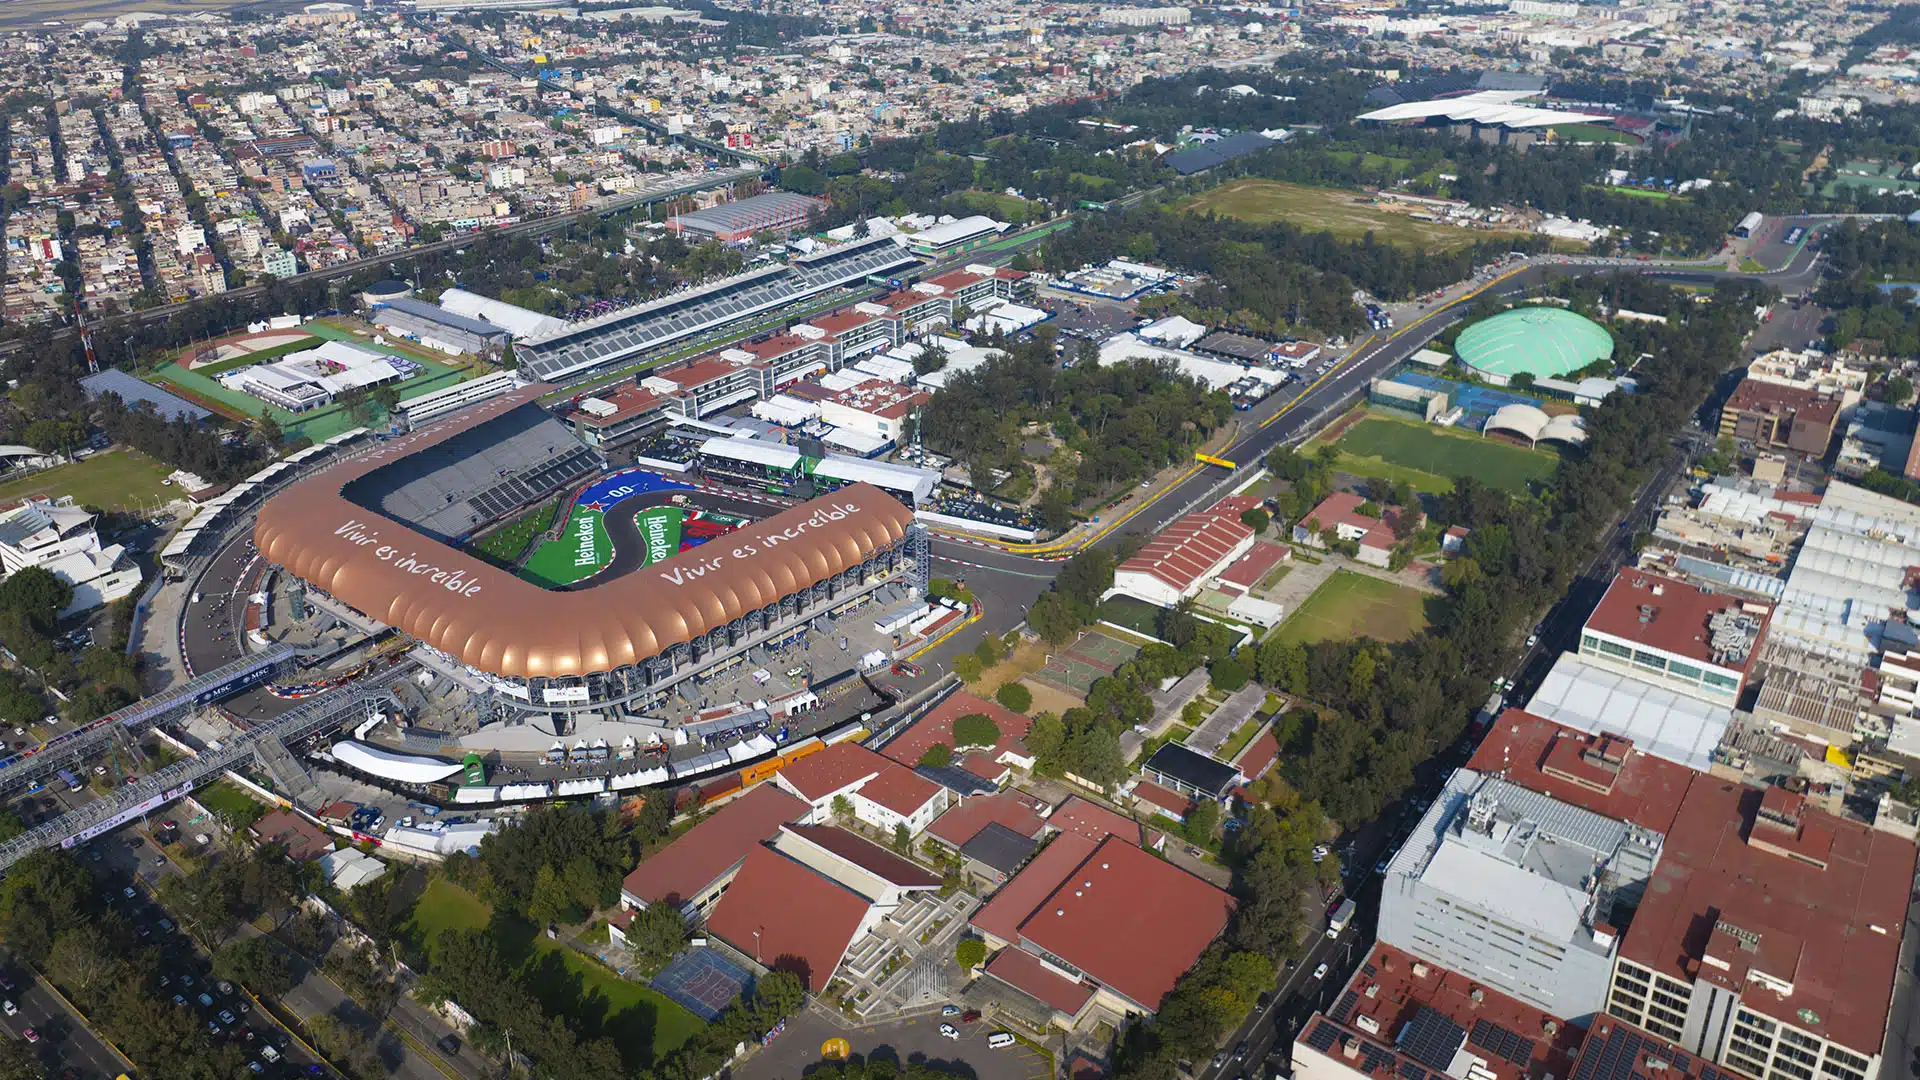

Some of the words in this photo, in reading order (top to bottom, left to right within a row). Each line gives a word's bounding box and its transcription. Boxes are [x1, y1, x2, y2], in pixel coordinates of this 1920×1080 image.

[334, 519, 378, 546] Vivir
[375, 545, 398, 560] es
[394, 552, 481, 597] increíble
[574, 516, 595, 567] Heineken
[660, 556, 723, 586] Vivir
[732, 544, 757, 559] es
[756, 502, 861, 549] increíble
[213, 683, 232, 697] MSC
[251, 667, 269, 679] MSC
